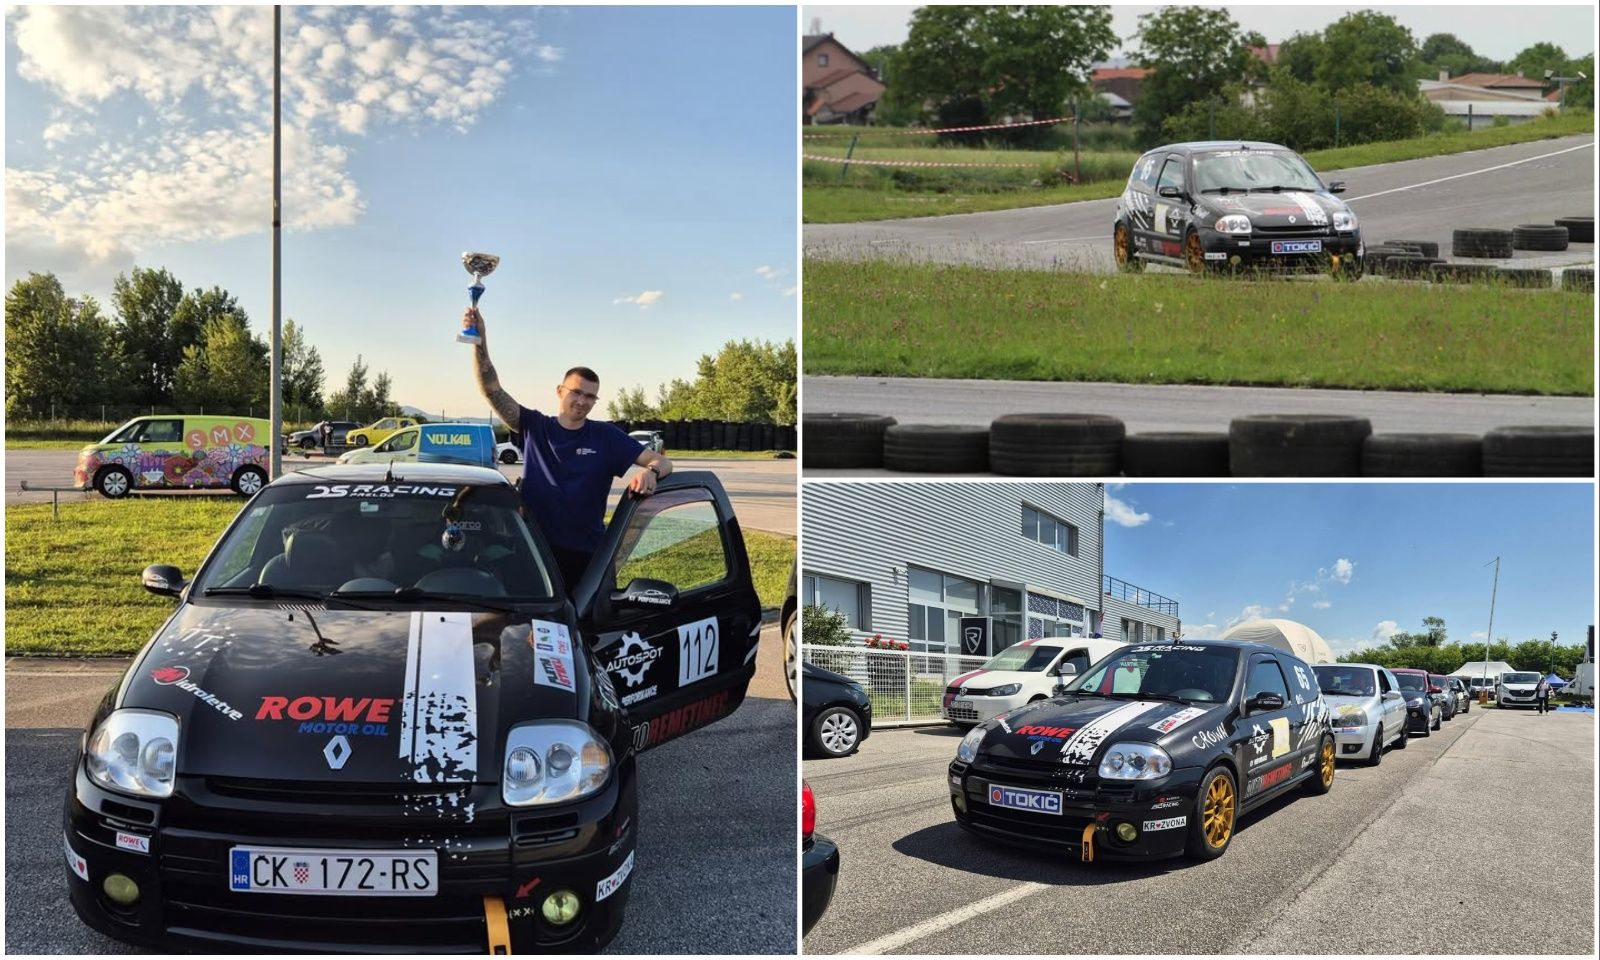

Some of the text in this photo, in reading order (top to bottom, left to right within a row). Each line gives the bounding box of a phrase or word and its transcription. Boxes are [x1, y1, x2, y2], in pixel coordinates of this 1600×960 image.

[351, 484, 457, 496] RACING
[449, 521, 482, 530] parco
[683, 624, 716, 680] 112
[605, 647, 664, 673] AUTOSPOT
[255, 696, 394, 723] ROWE
[298, 722, 389, 736] MOTOR OIL
[1015, 725, 1076, 738] ROWE
[1005, 791, 1059, 811] TOKIĆ
[1161, 818, 1186, 829] ZVONA
[118, 835, 140, 846] ROWE
[233, 873, 249, 884] HR
[253, 854, 430, 890] ČK 172-RS
